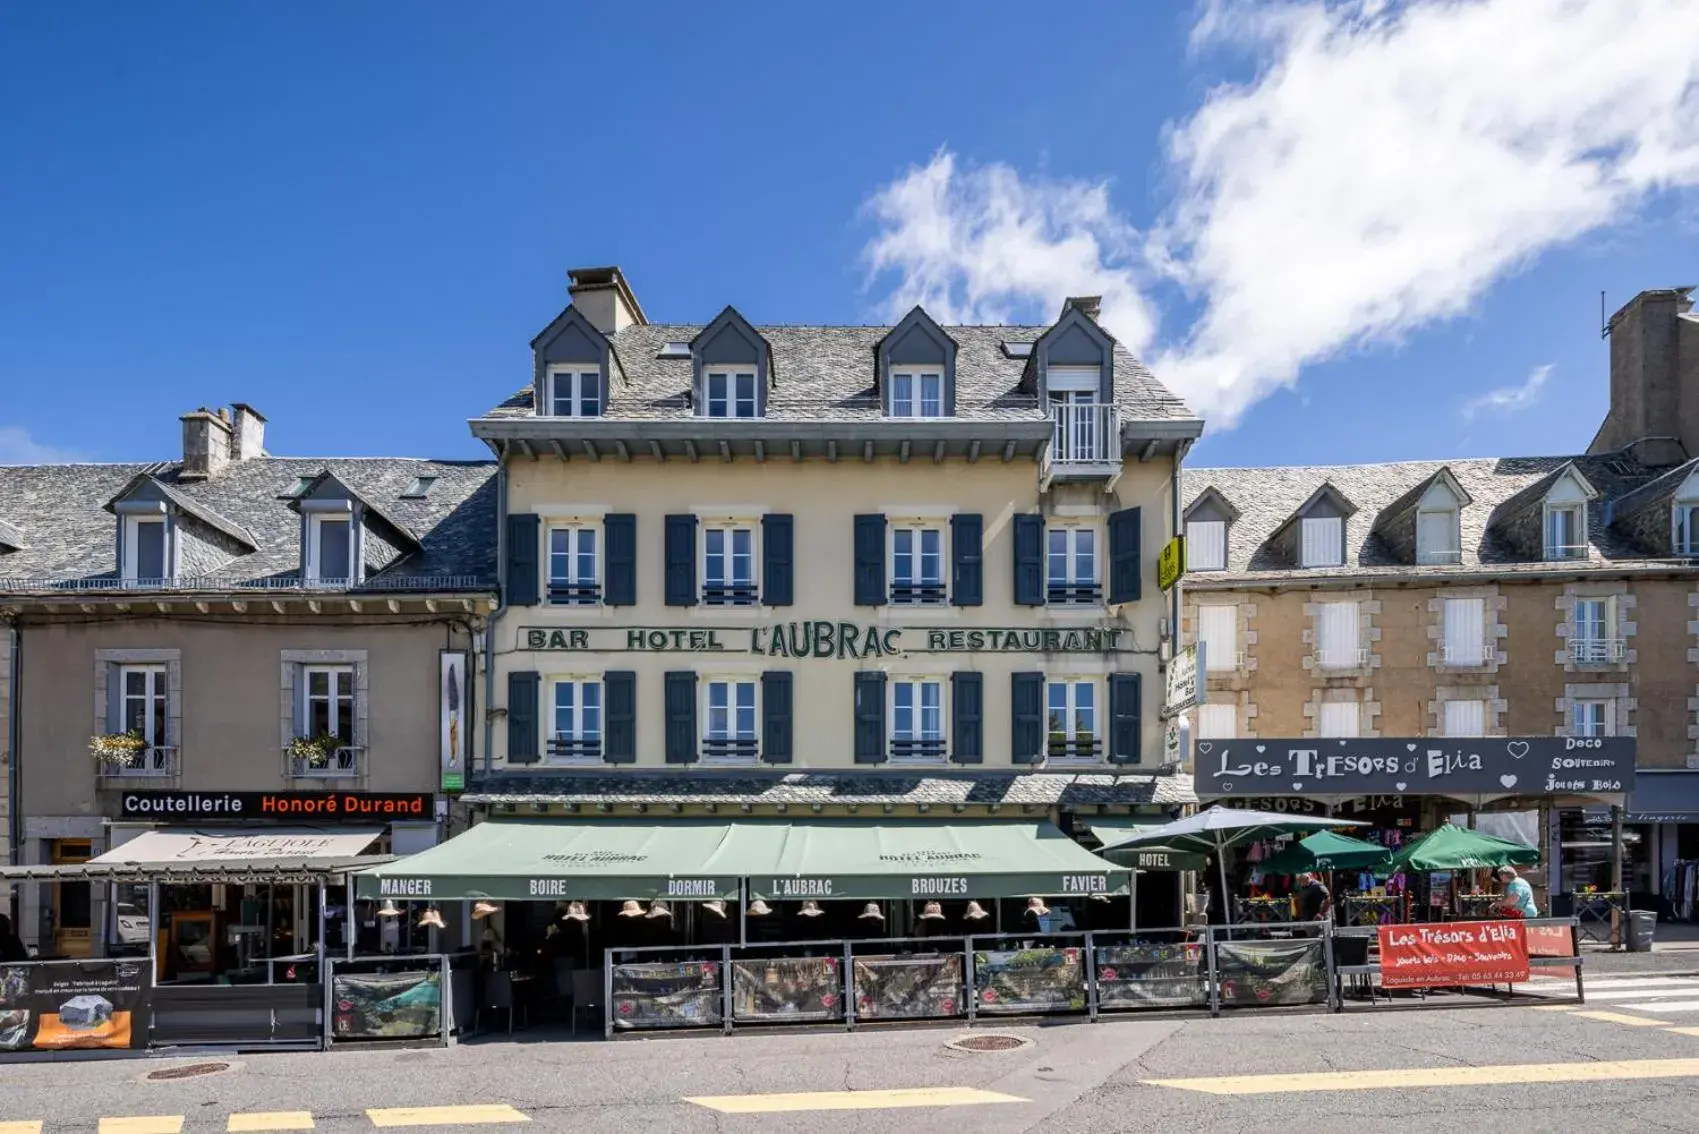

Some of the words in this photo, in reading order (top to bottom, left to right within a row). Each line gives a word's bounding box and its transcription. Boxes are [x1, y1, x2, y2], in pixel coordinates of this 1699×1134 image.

[527, 629, 589, 649] BAR
[626, 629, 724, 651] HOTEL
[751, 620, 902, 660] L'AUBRAC
[928, 629, 1123, 651] RESTAURANT
[1213, 749, 1282, 777] Les
[1427, 749, 1483, 778] Elia
[124, 794, 243, 813] Coutellerie
[261, 794, 337, 813] Honoré
[344, 795, 422, 813] Durand
[1138, 852, 1171, 868] HOTEL
[380, 879, 433, 896] MANGER
[529, 879, 567, 896] BOIRE
[667, 879, 716, 896] DORMIR
[772, 878, 833, 896] L'AUBRAC
[911, 877, 968, 894] BROUZES
[1062, 874, 1107, 892] FAVIER
[1389, 930, 1417, 947] Les
[1419, 927, 1475, 945] Trésors
[1478, 924, 1517, 944] d'Elia
